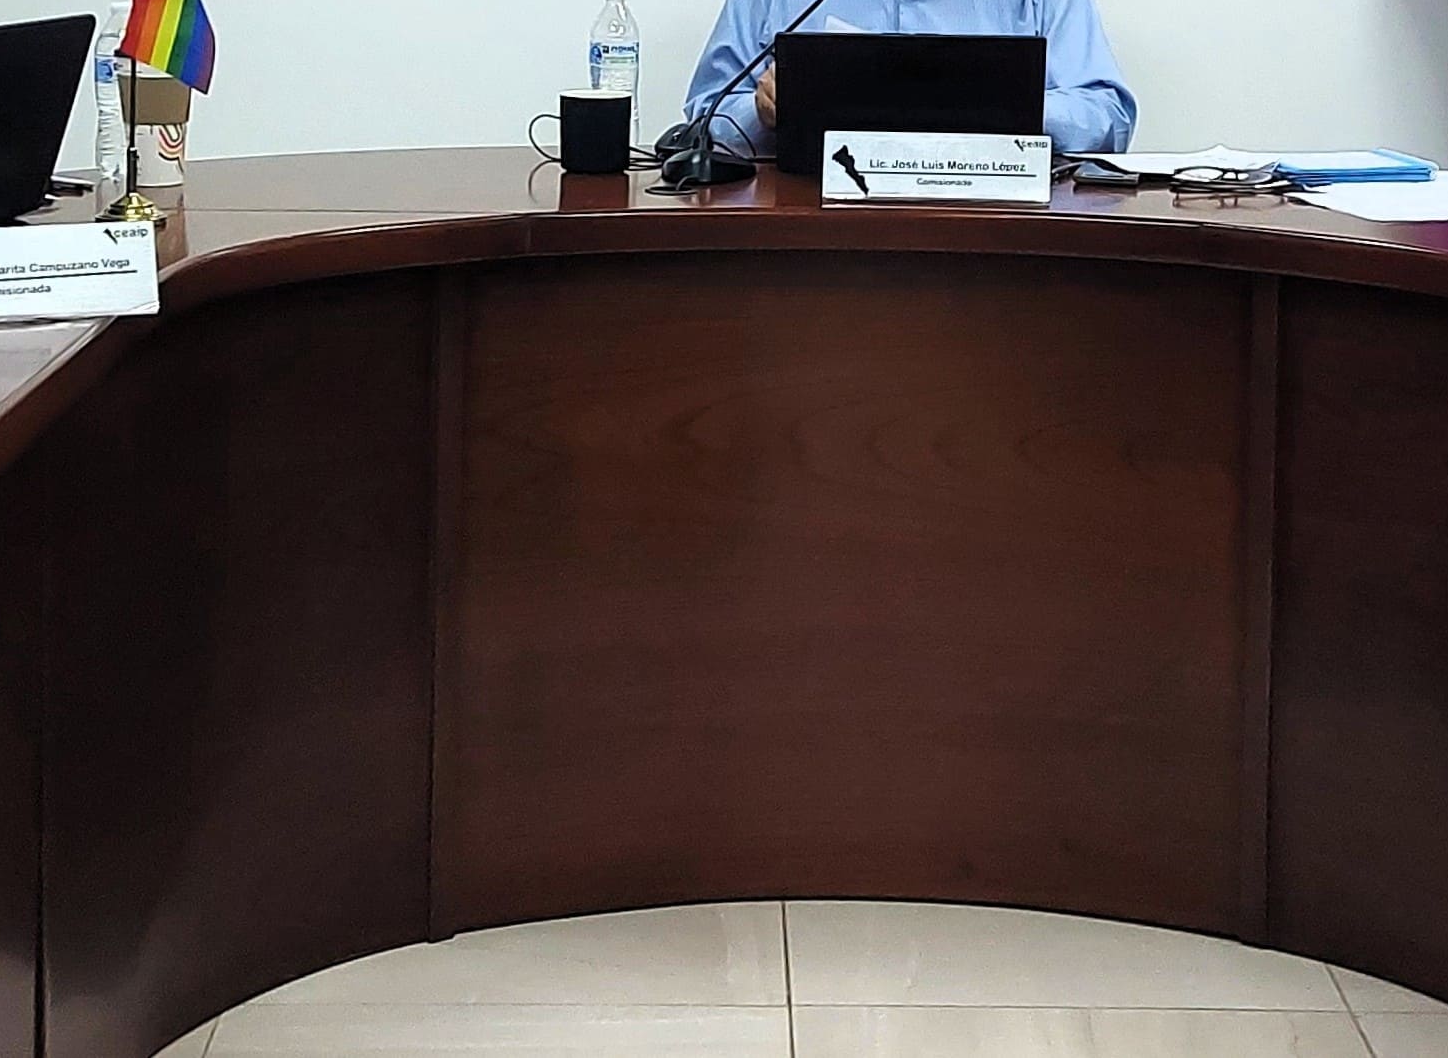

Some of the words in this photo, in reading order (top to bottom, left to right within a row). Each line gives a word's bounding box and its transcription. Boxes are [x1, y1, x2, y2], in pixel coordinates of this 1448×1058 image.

[892, 159, 918, 170] José
[921, 160, 944, 170] Luis
[947, 161, 990, 171] Moreno
[992, 161, 1027, 172] López
[113, 225, 149, 239] ceaip
[29, 259, 99, 274] Campuzano
[101, 257, 131, 270] Vega
